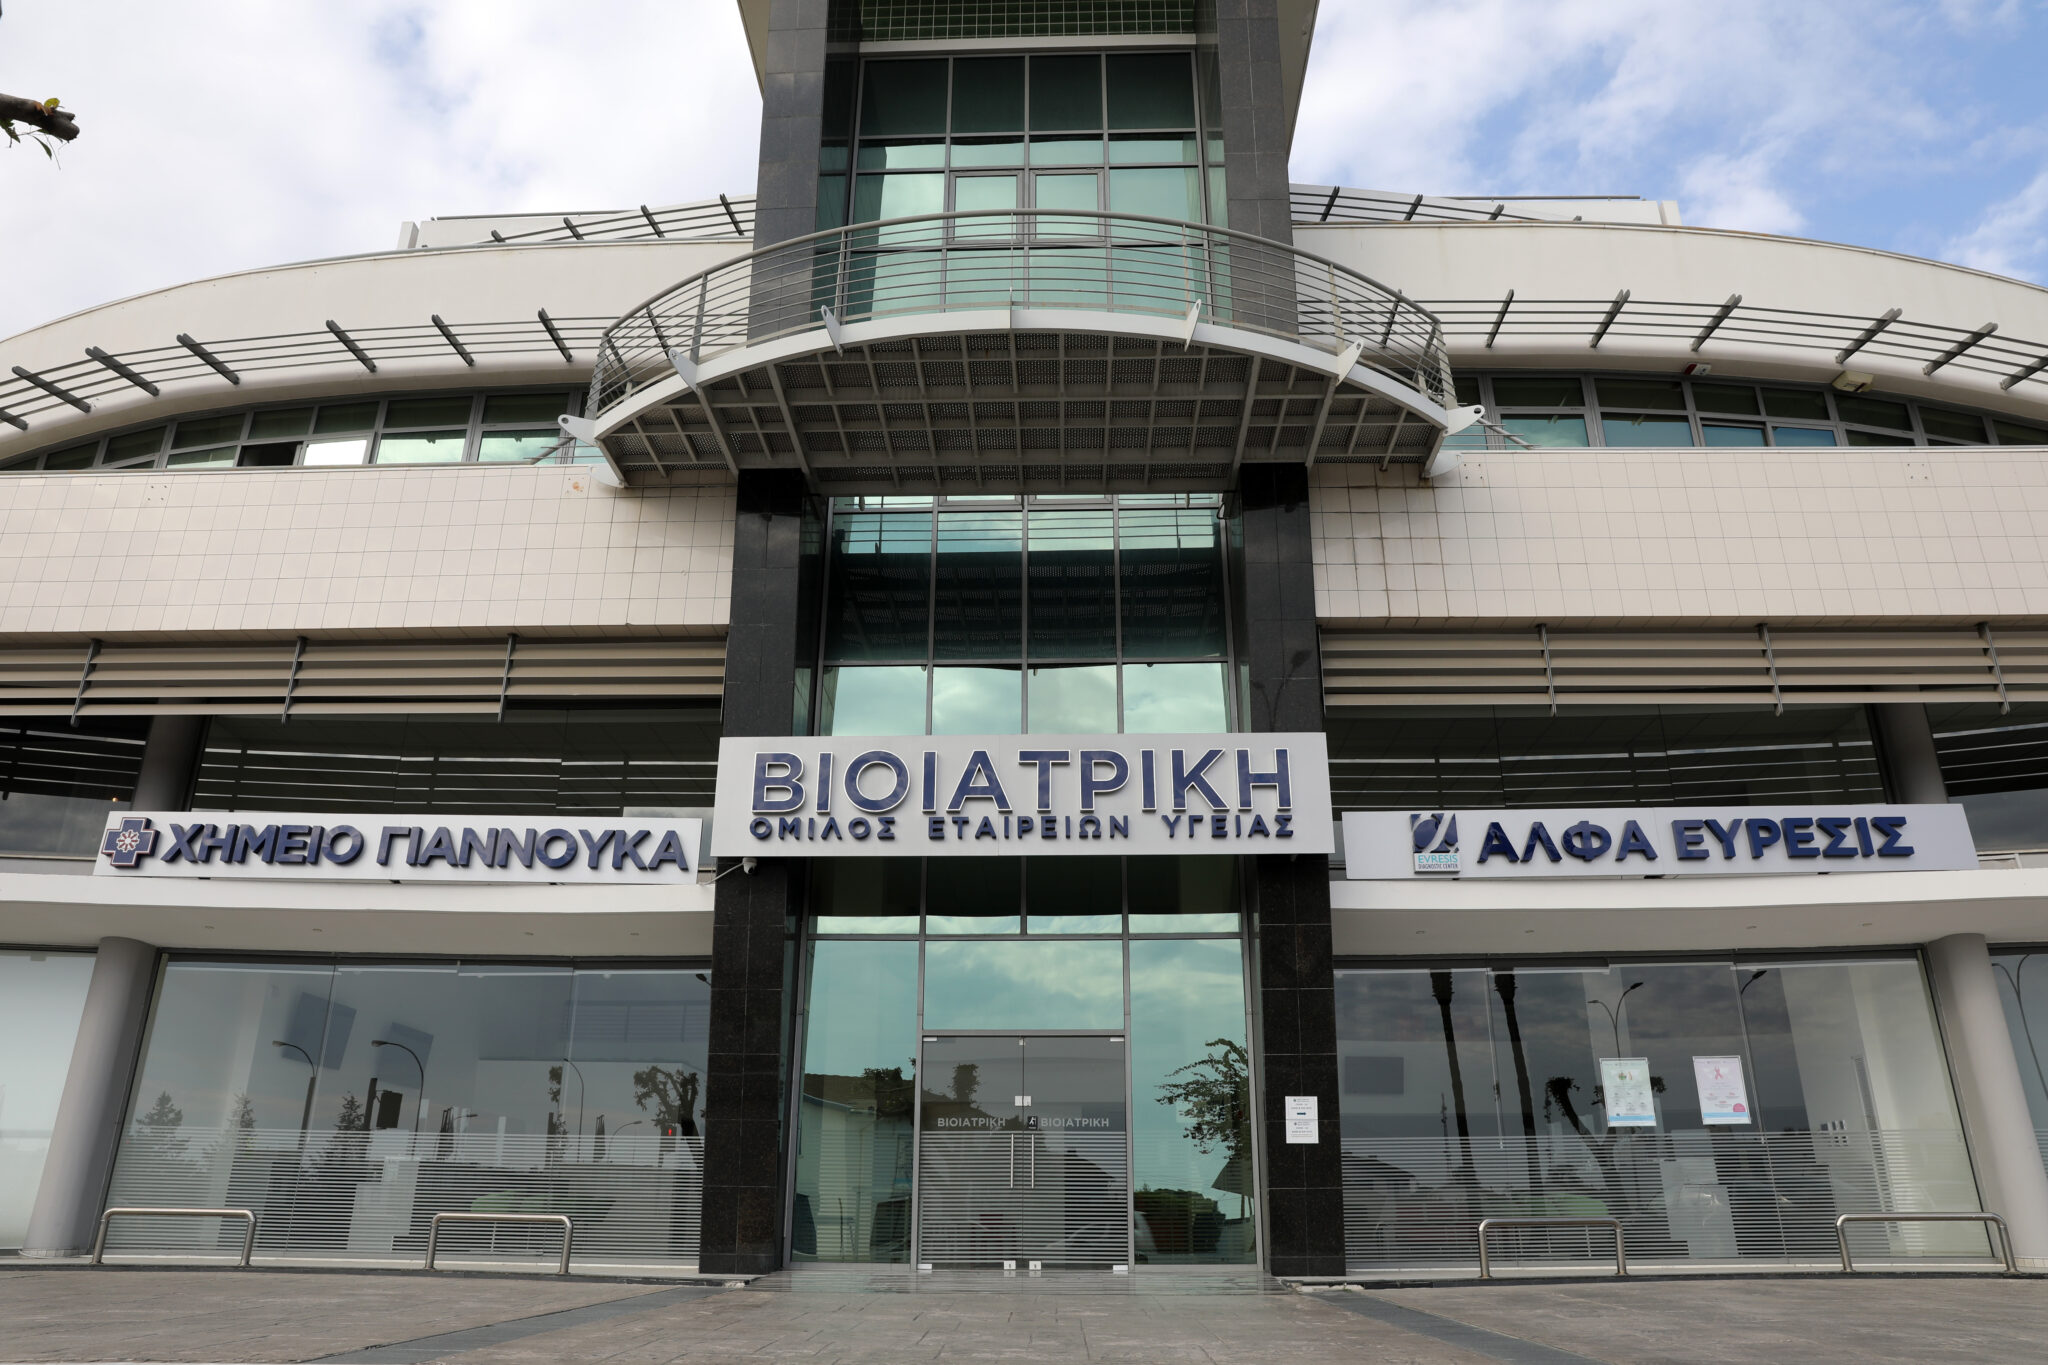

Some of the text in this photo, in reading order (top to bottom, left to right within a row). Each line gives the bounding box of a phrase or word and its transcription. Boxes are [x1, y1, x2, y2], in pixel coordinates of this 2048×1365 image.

[752, 748, 1293, 814] ΒΙΟΙΑΤΡΙΚΗ
[749, 814, 1294, 840] ΟΜΙΛΟΣ ΕΤΑΙΡΕΙΩΝ ΥΓΕΙΑΣ
[1476, 817, 1914, 863] ΑΛΦΑ ΕΥΡΕΣΙΣ
[161, 824, 688, 871] ΧΗΜΕΙΟ ΓΙΑΝΝΟΥΚΑ
[1418, 855, 1458, 863] EVRESIS
[937, 1117, 1006, 1127] ΒΙΟΙΑΤΡΙΚΗ
[1041, 1117, 1109, 1127] ΒΙΟΙΑΤΡΙΚΗ
